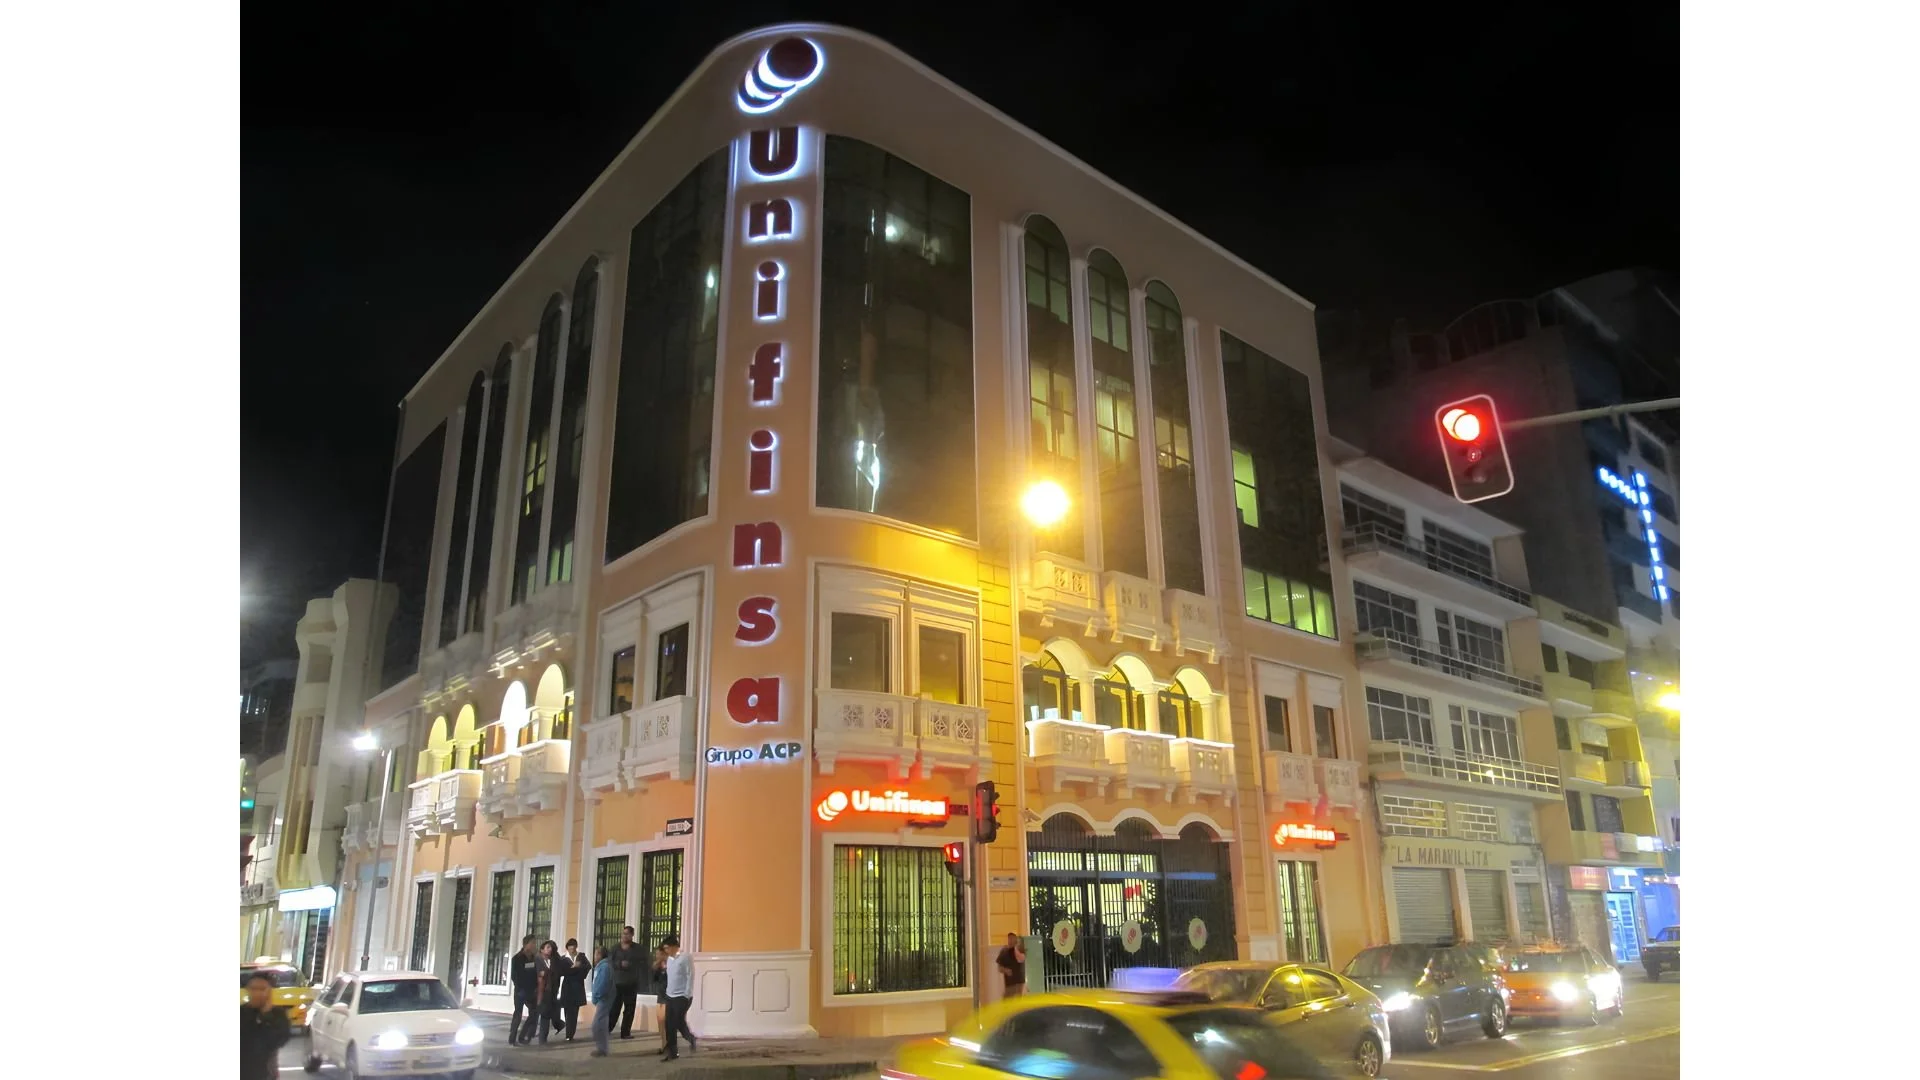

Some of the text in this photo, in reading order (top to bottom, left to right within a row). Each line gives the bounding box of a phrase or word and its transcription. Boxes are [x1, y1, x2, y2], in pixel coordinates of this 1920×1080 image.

[727, 126, 799, 724] Unifinsa
[705, 743, 801, 765] Grupo ACP
[851, 790, 946, 816] Unifinsa
